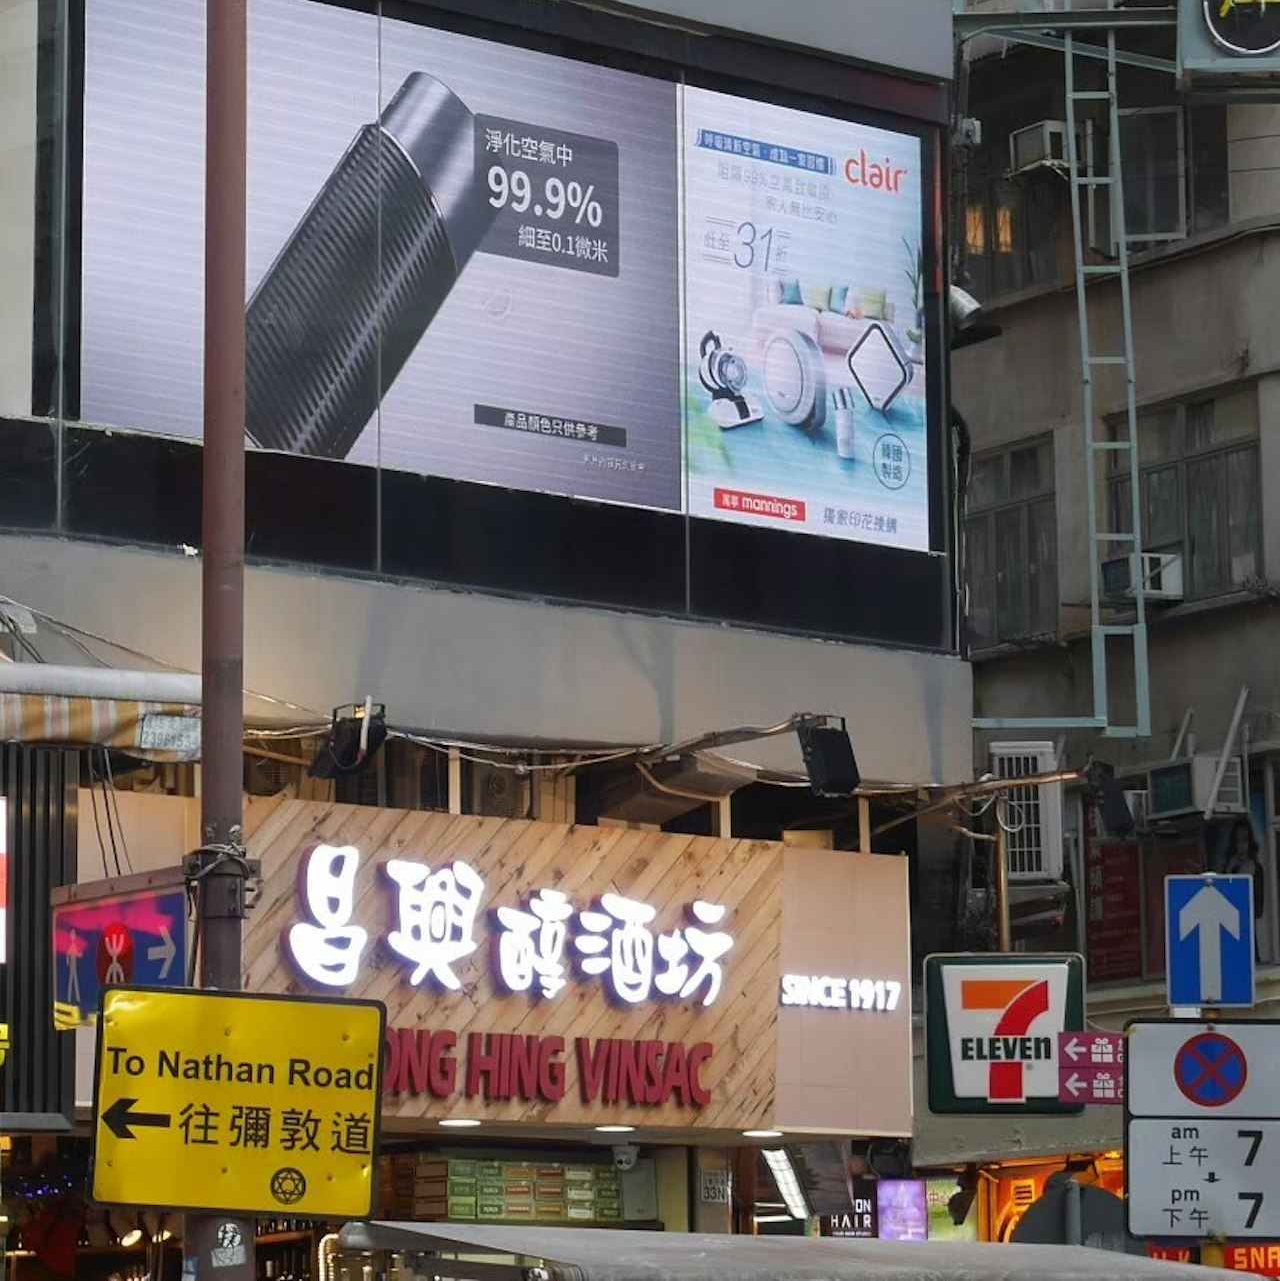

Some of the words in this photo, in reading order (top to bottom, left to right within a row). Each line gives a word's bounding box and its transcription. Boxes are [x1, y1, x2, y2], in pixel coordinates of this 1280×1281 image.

[483, 126, 574, 165] 淨化空氣中
[844, 148, 901, 193] clair
[486, 165, 604, 227] 99.9%
[518, 224, 609, 264] 細至0.1微米
[742, 495, 798, 519] mannings
[780, 973, 848, 1009] SINCE
[849, 976, 902, 1011] 1917
[107, 1046, 146, 1078] To
[157, 1050, 276, 1085] Nathan
[287, 1056, 375, 1092] Road
[466, 1031, 566, 1103] HING
[576, 1037, 717, 1108] VINSAC
[177, 1102, 372, 1156] 往彌敦道
[1172, 1126, 1200, 1140] am
[1237, 1131, 1264, 1168] 7
[1162, 1145, 1210, 1167] 上午
[830, 1214, 872, 1229] HAIR
[1162, 1208, 1210, 1230] 下午
[1171, 1188, 1200, 1205] pm
[1238, 1192, 1264, 1230] 7
